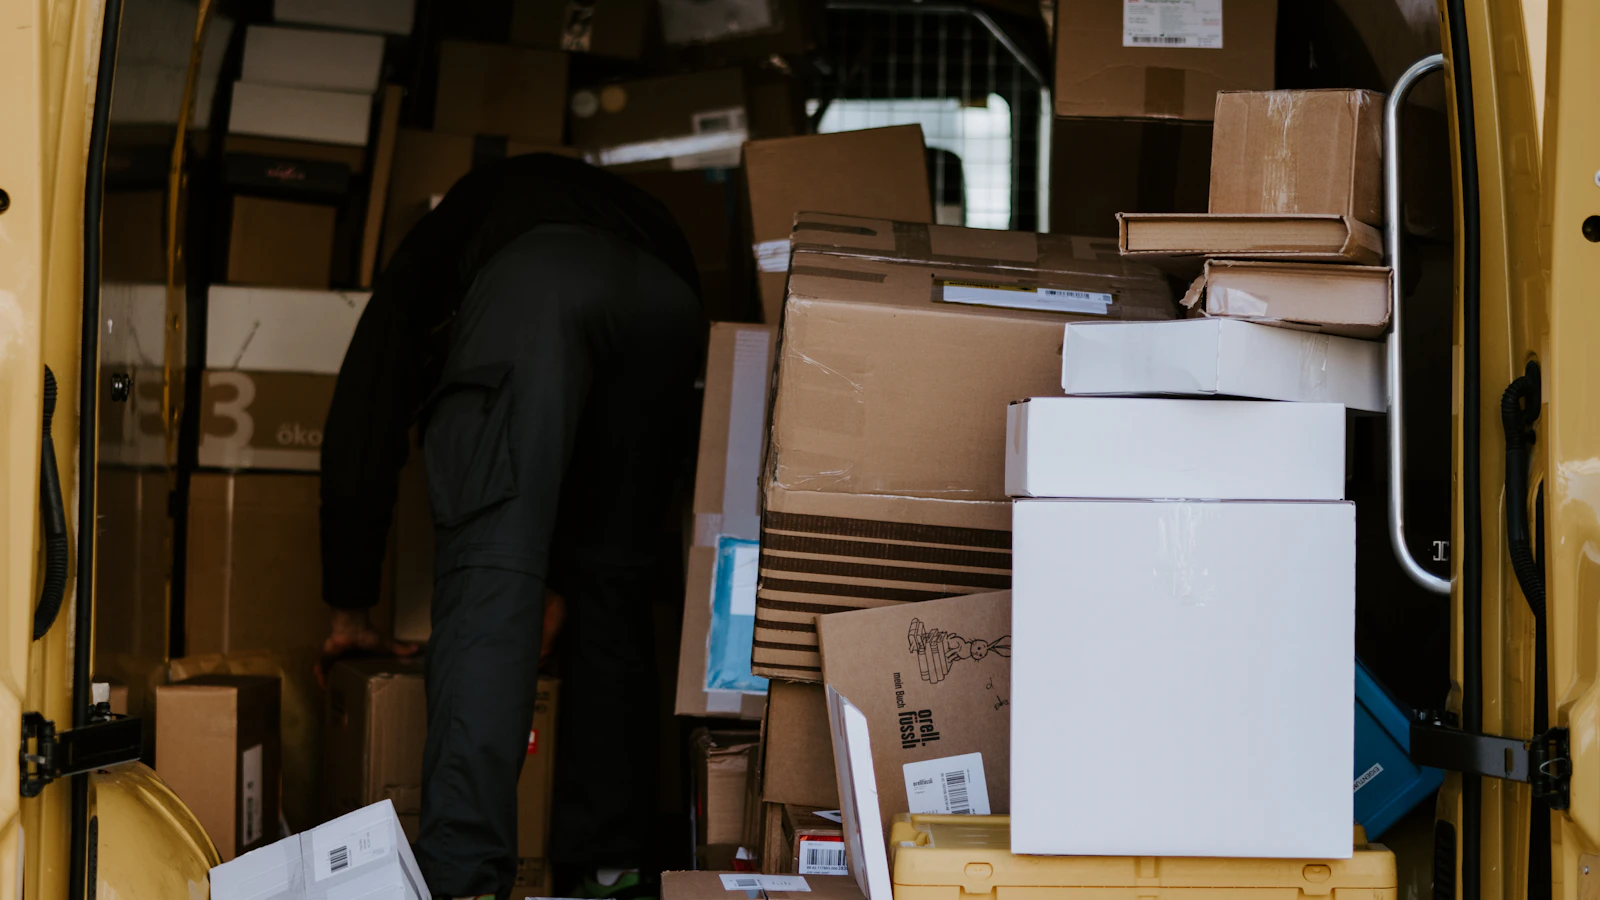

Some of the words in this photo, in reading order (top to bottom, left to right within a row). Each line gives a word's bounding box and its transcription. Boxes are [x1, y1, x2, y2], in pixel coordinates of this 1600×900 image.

[203, 371, 256, 450] 3
[275, 421, 324, 447] öko
[893, 672, 905, 689] mein
[895, 690, 906, 709] Buch
[898, 711, 921, 749] füssli
[917, 709, 941, 747] orell.
